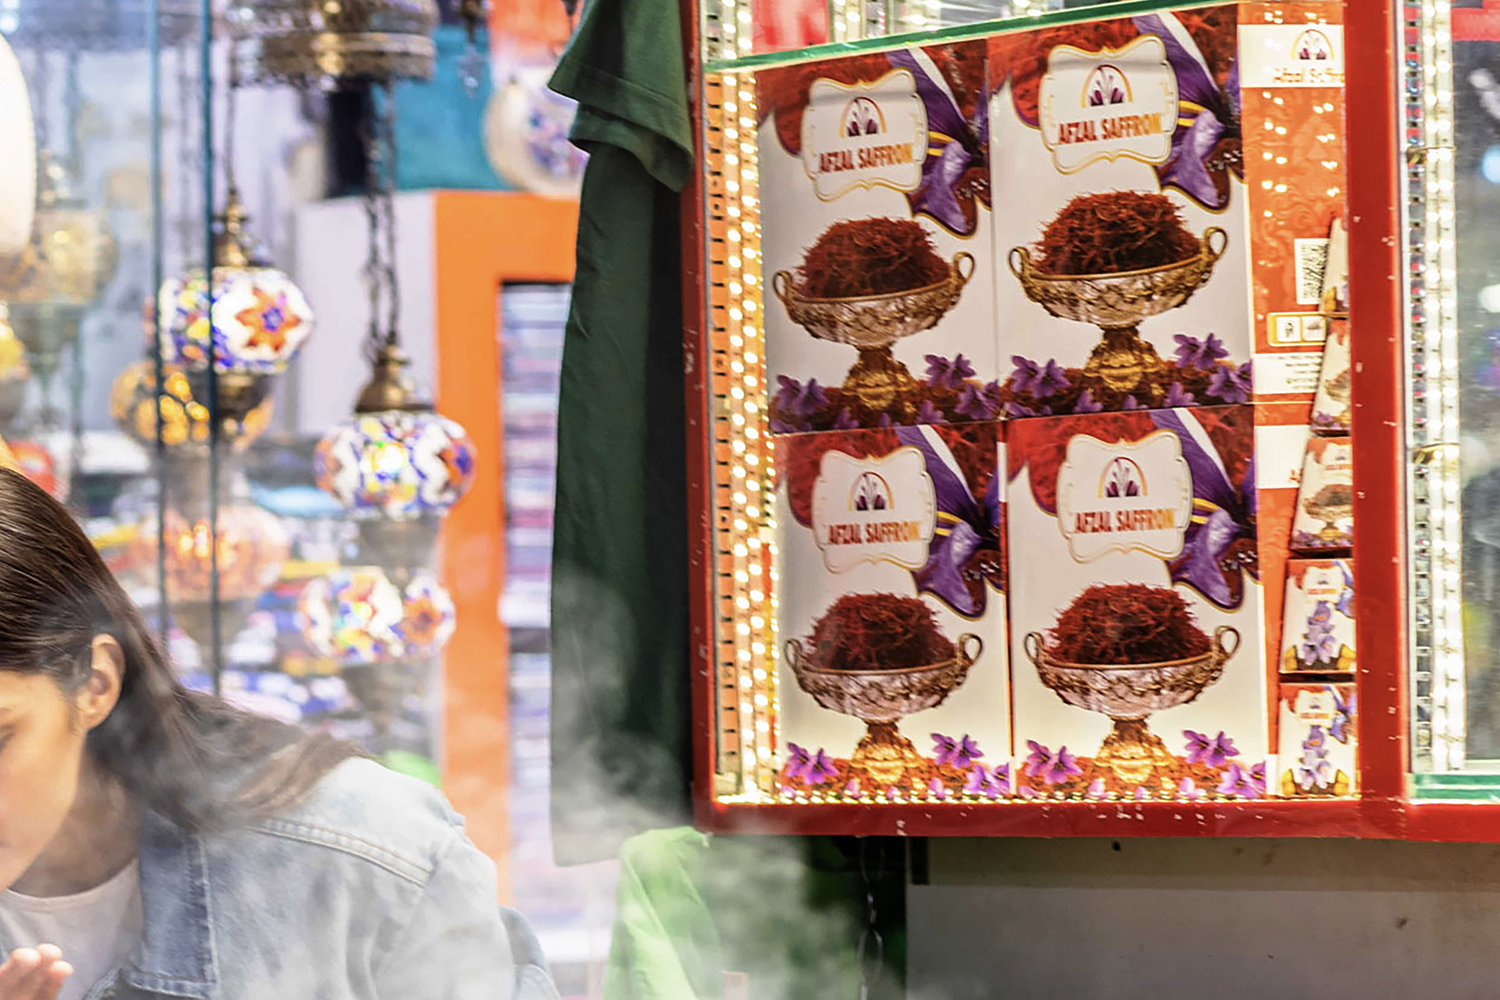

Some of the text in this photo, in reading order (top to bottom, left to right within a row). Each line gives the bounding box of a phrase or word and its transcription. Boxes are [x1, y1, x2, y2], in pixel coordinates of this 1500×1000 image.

[1059, 112, 1162, 144] AFZAL SAFFRON
[820, 142, 913, 173] AFZAL SAFFRON
[828, 521, 920, 545] AFZAL SAFFRON
[1075, 508, 1175, 533] AFZAL SAFFRON
